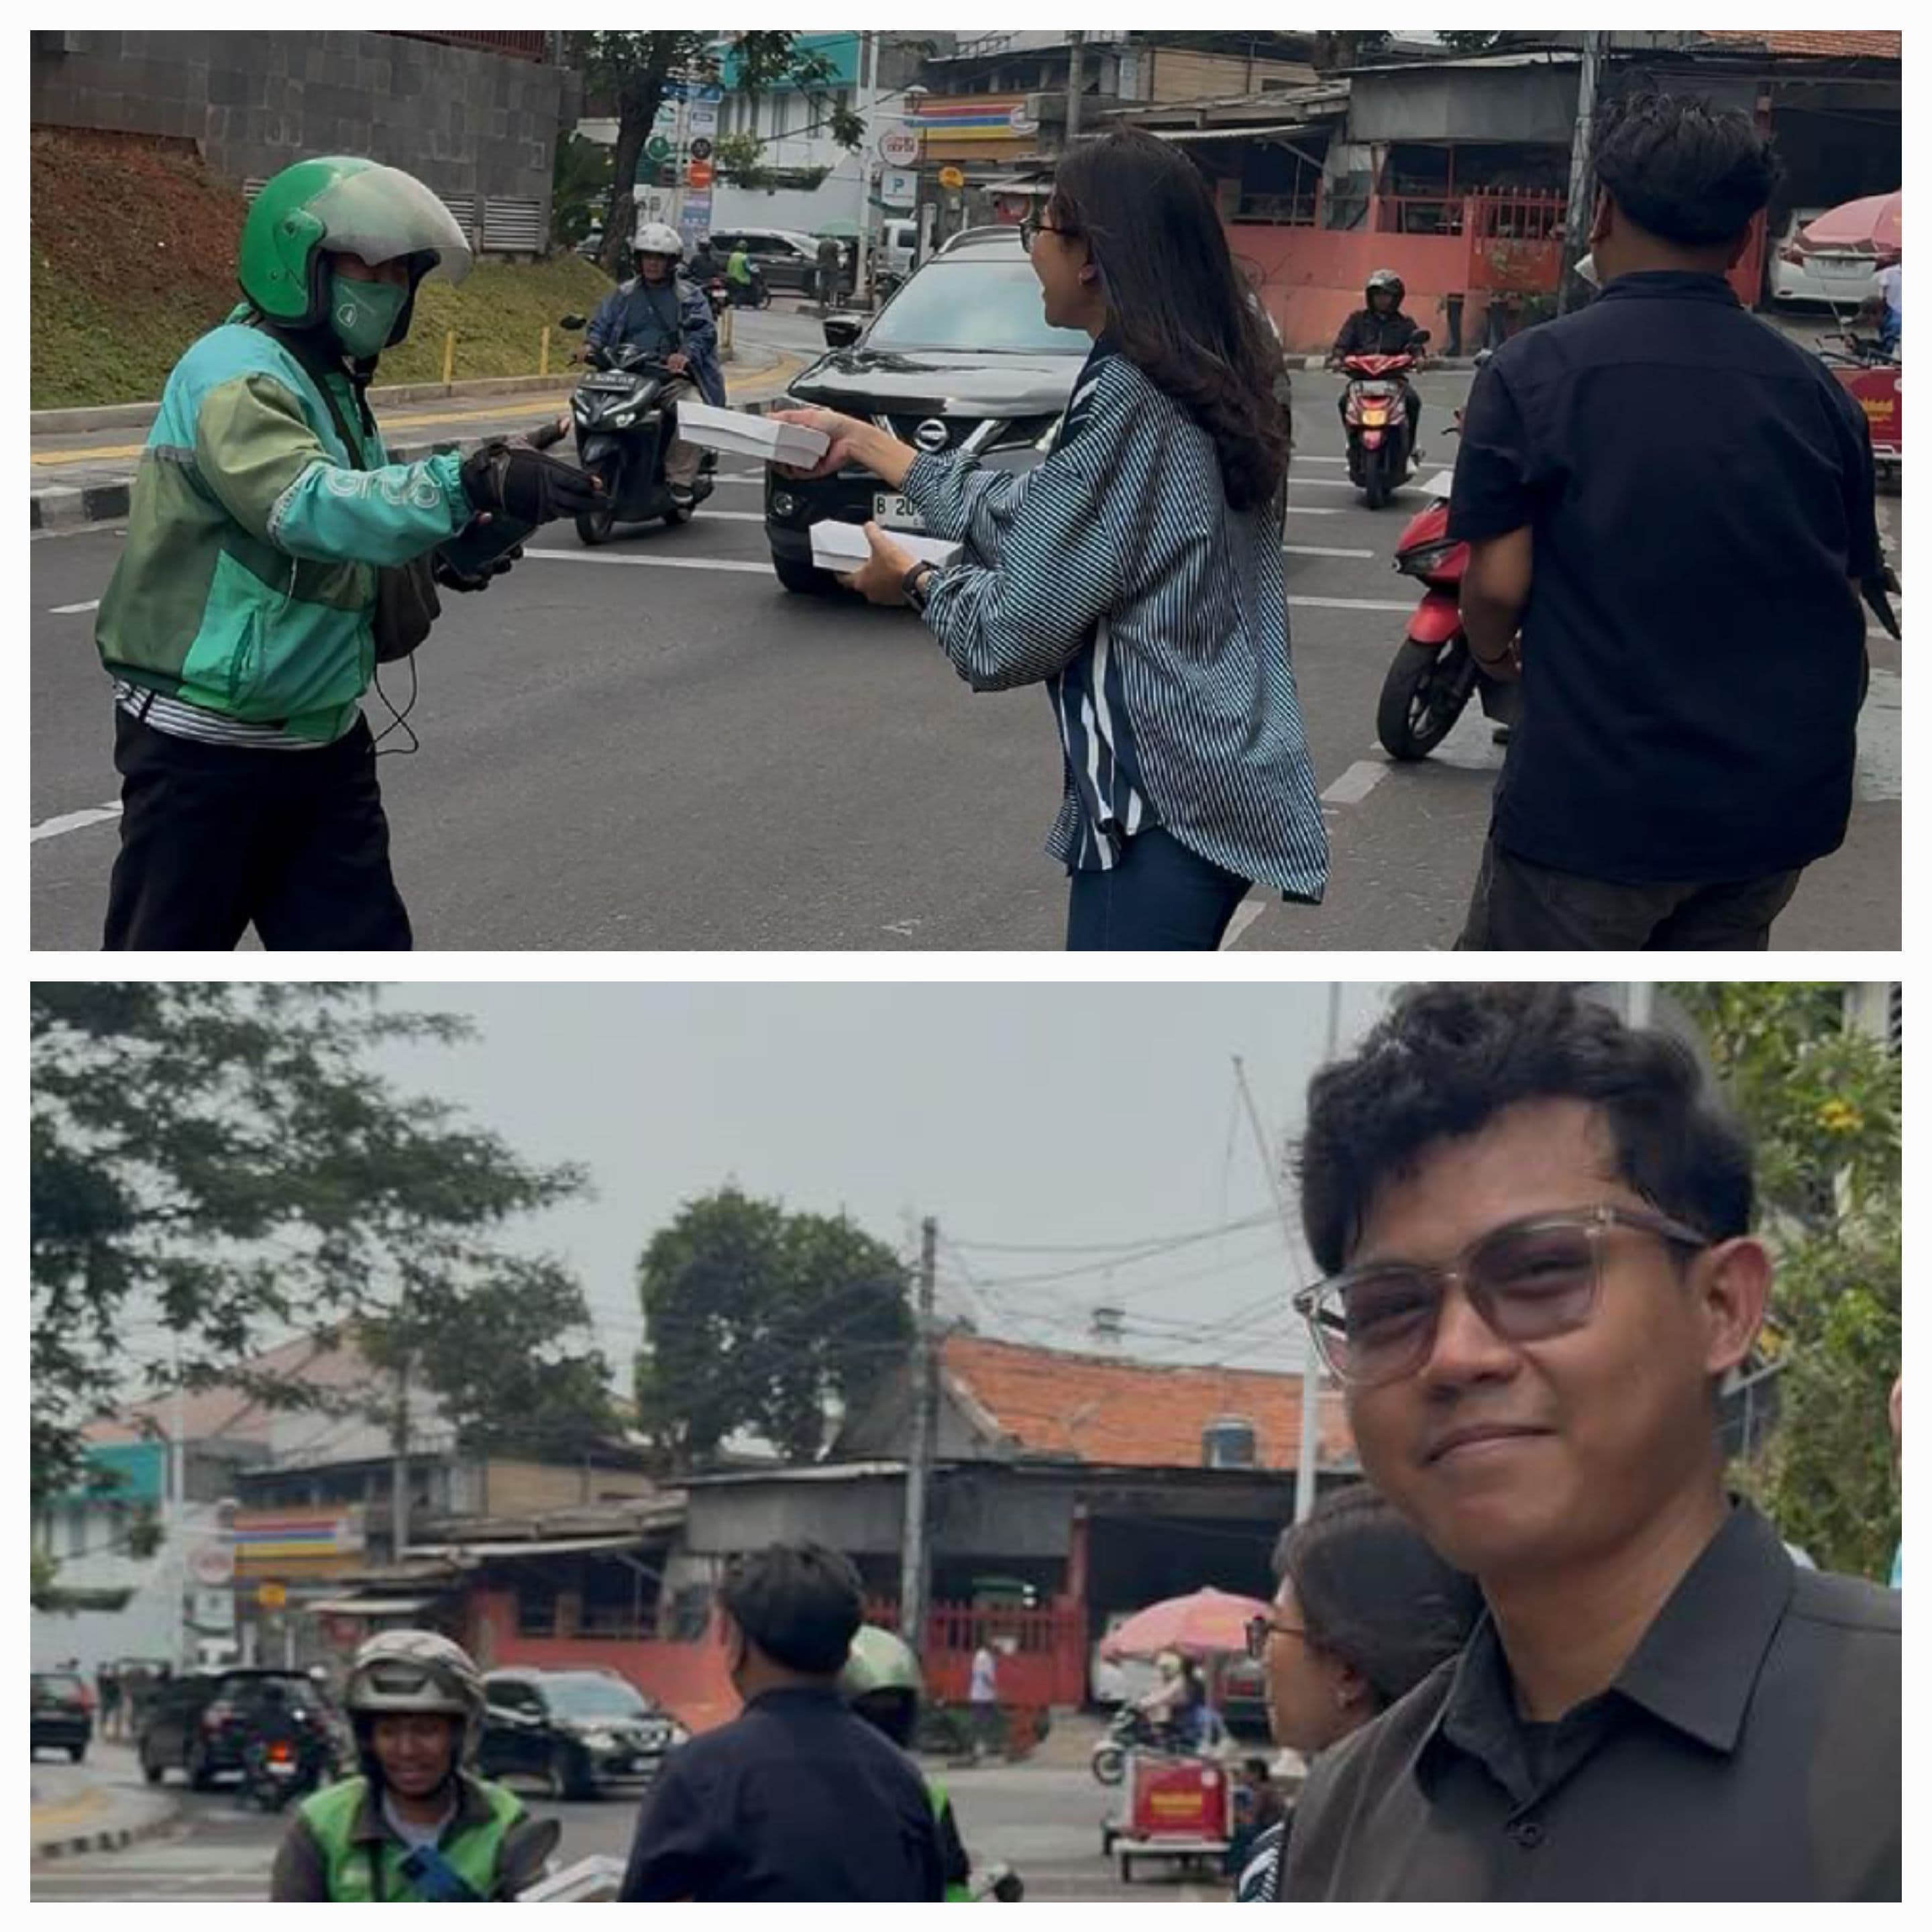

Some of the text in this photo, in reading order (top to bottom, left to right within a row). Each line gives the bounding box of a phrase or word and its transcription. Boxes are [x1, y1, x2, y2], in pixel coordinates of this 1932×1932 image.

[894, 177, 905, 193] P
[877, 496, 918, 516] B 20
